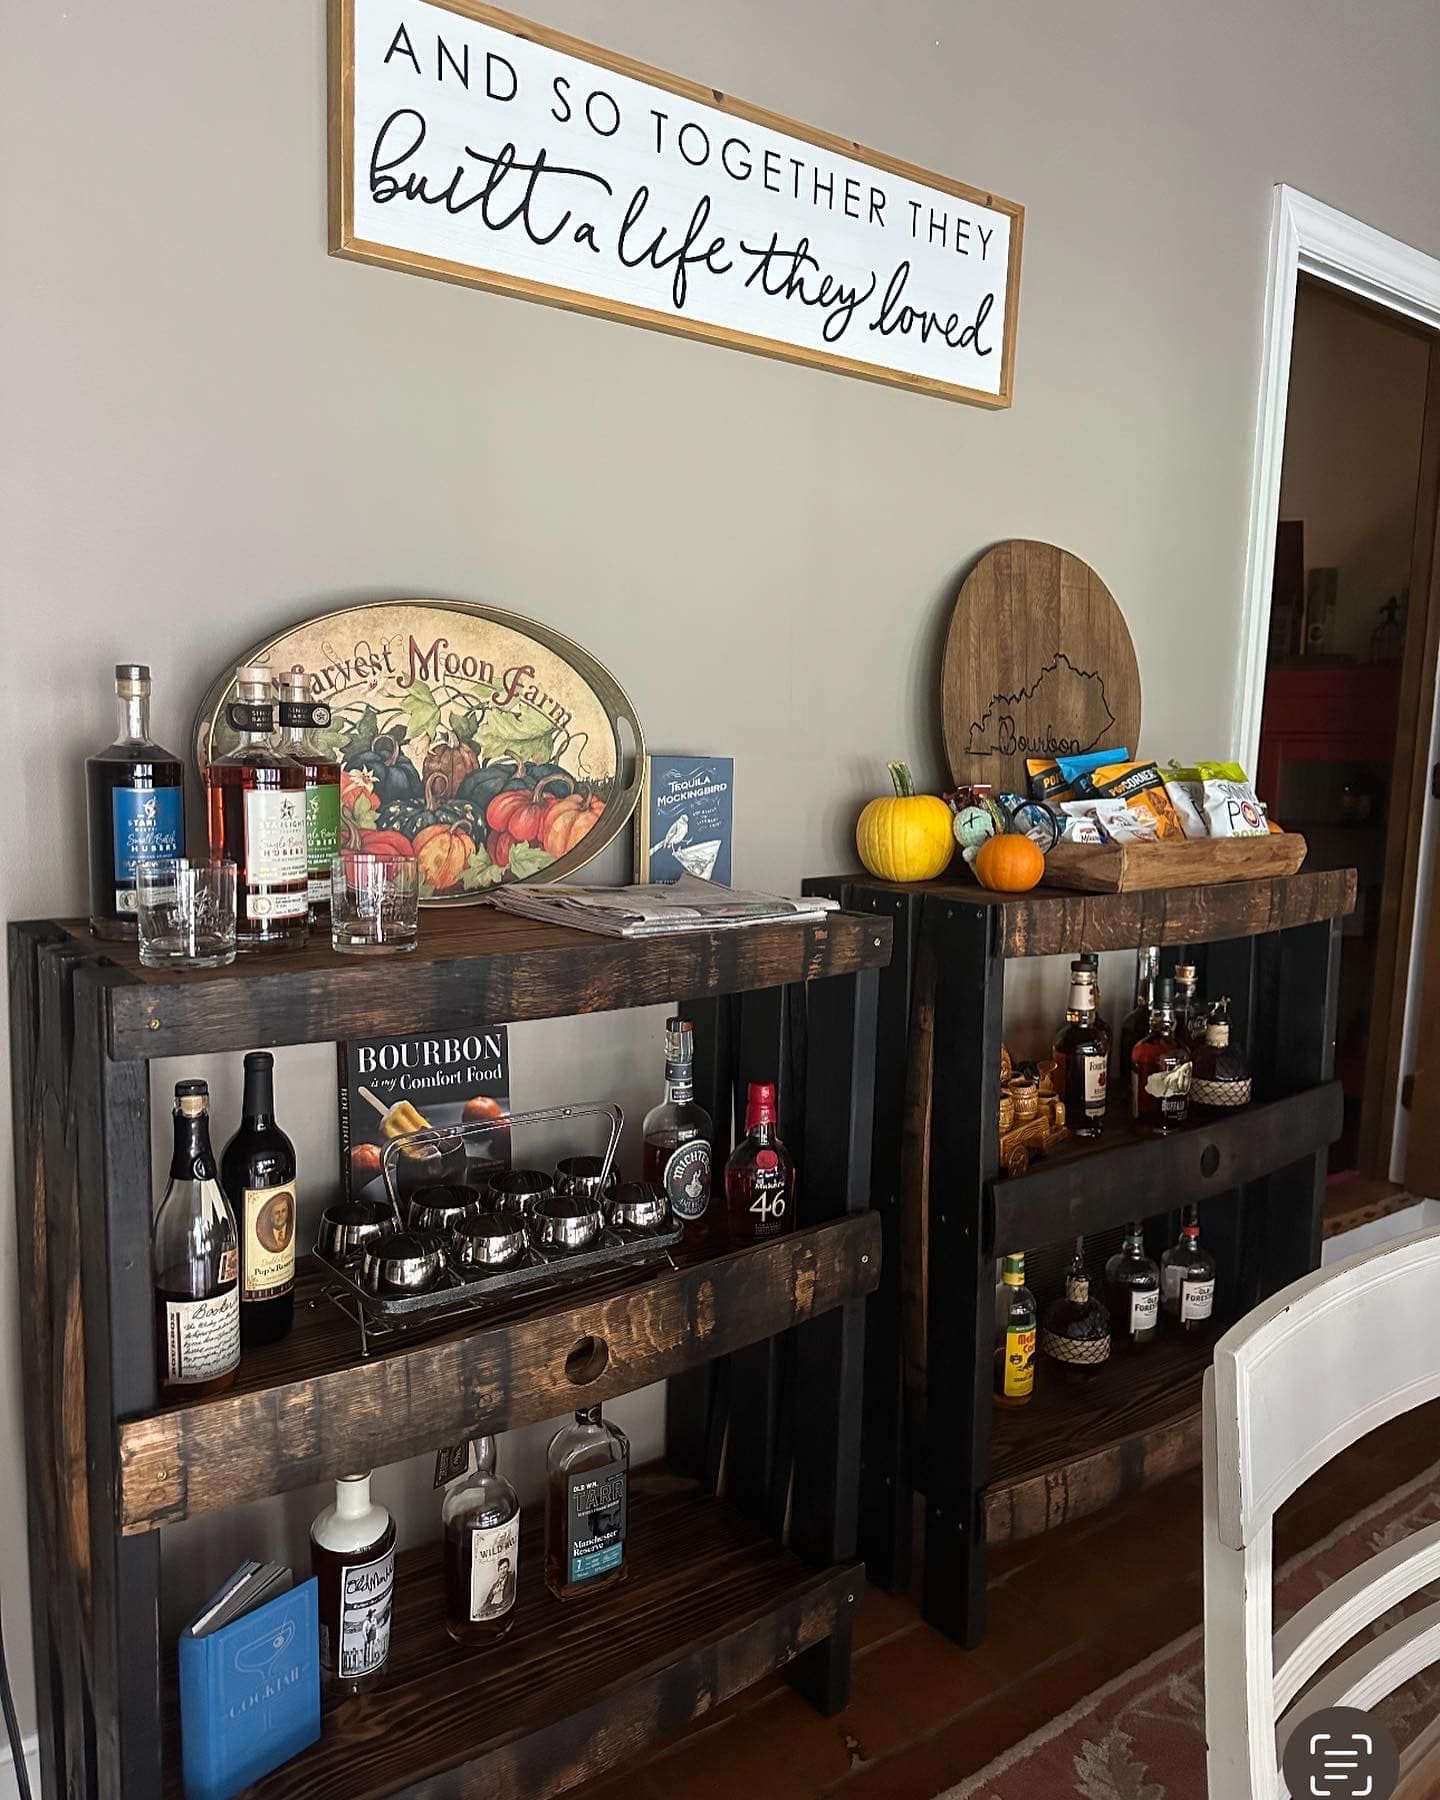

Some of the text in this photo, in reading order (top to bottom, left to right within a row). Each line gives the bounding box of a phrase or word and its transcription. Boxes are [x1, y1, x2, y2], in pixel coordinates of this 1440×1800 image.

[383, 22, 993, 261] AND SO TOGETHER THEY
[370, 108, 994, 356] built a life they loved
[396, 634, 495, 688] Moon
[492, 665, 573, 729] Farm
[991, 715, 1082, 756] Bourbon
[657, 782, 728, 808] MOCKINGBIRD
[668, 775, 711, 793] TEQUILA
[357, 1033, 502, 1073] BOURBON
[400, 1070, 462, 1090] Comfort
[467, 1063, 503, 1083] Food
[749, 1190, 786, 1223] 46
[574, 1479, 624, 1512] TARR
[480, 1545, 503, 1559] WILD
